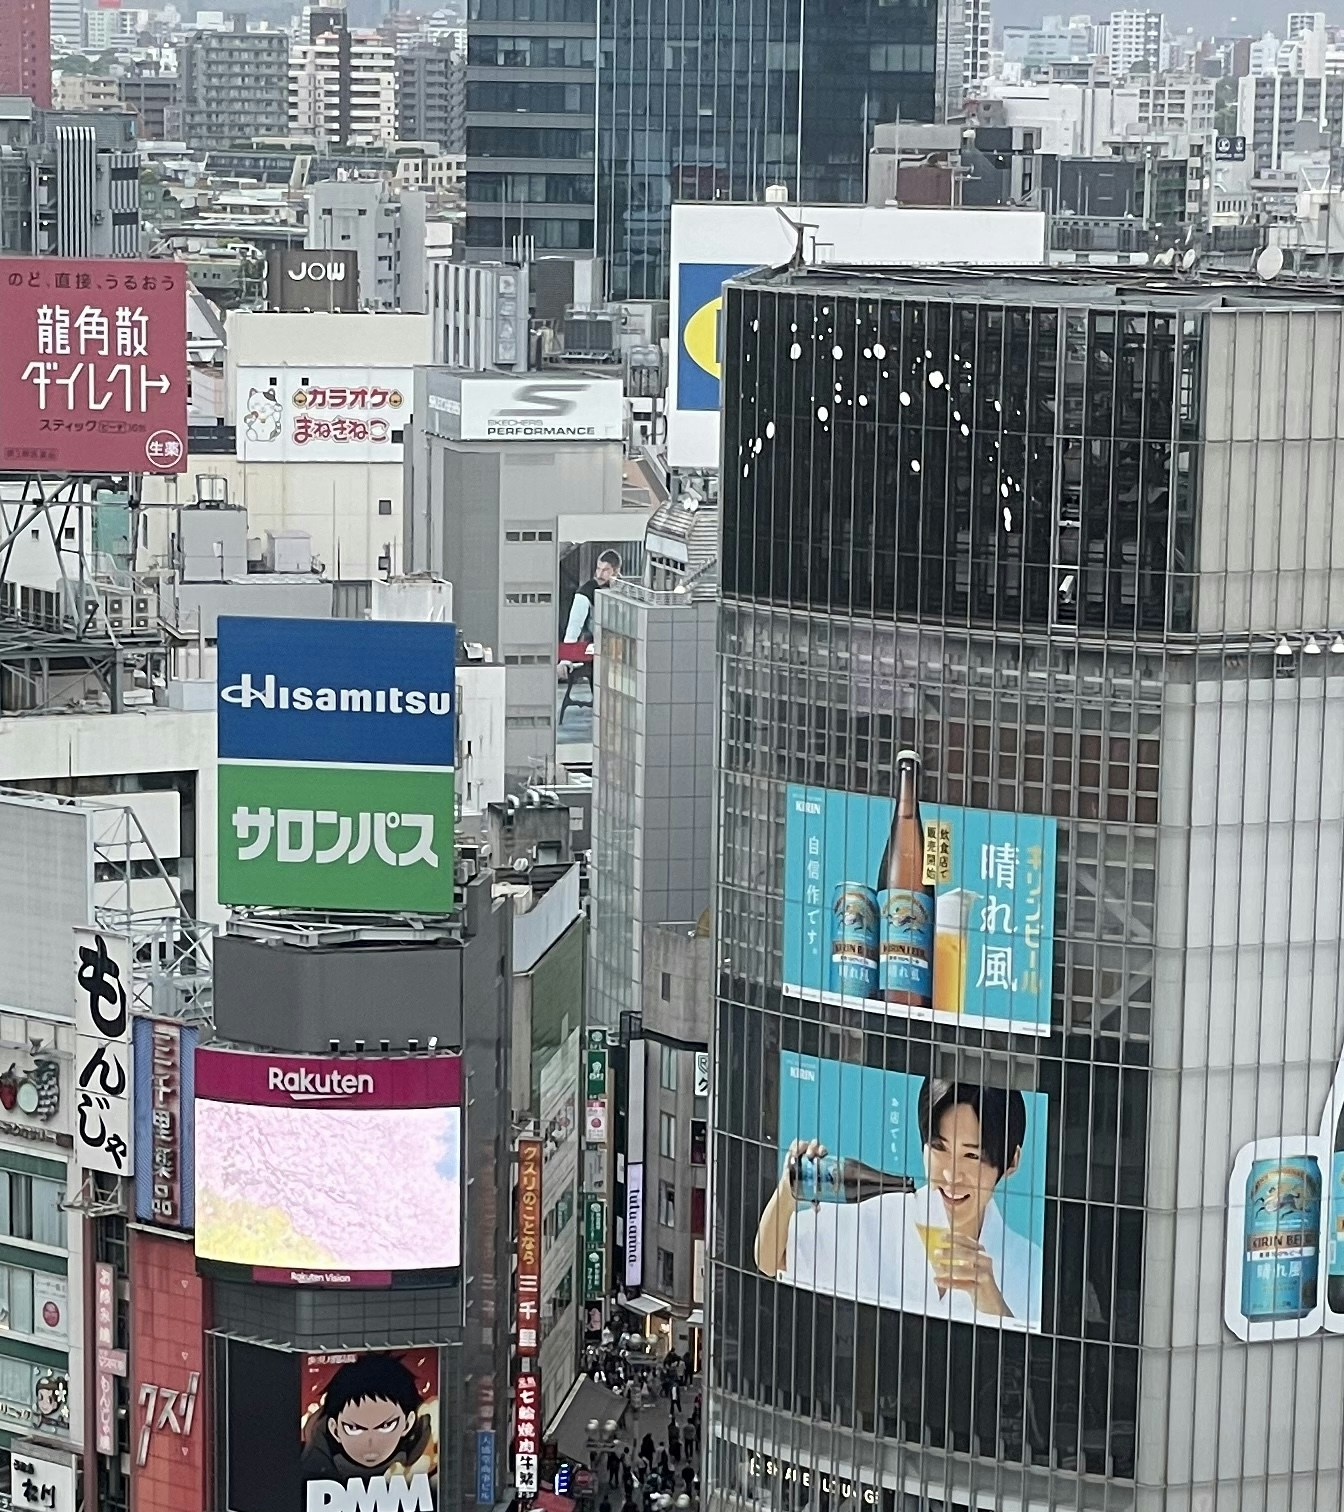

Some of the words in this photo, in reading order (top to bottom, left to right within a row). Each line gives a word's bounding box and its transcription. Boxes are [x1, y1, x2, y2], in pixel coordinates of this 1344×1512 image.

[8, 271, 176, 291] のど、直接、うるおう
[287, 262, 345, 281] JOW
[36, 304, 150, 357] 龍角散
[20, 361, 171, 413] ダイレクト
[307, 387, 390, 409] カラオケ
[40, 418, 97, 432] スティック
[292, 416, 391, 445] まねきねこ
[487, 426, 595, 436] PERFORMANCE
[220, 673, 451, 715] Hisamitsu
[232, 805, 439, 869] サロンパス
[976, 843, 1020, 992] 晴れ風
[77, 934, 127, 1170] もんじゃ
[268, 1066, 374, 1096] Rakuten
[325, 1273, 351, 1283] Vision
[519, 1274, 538, 1348] 三千里
